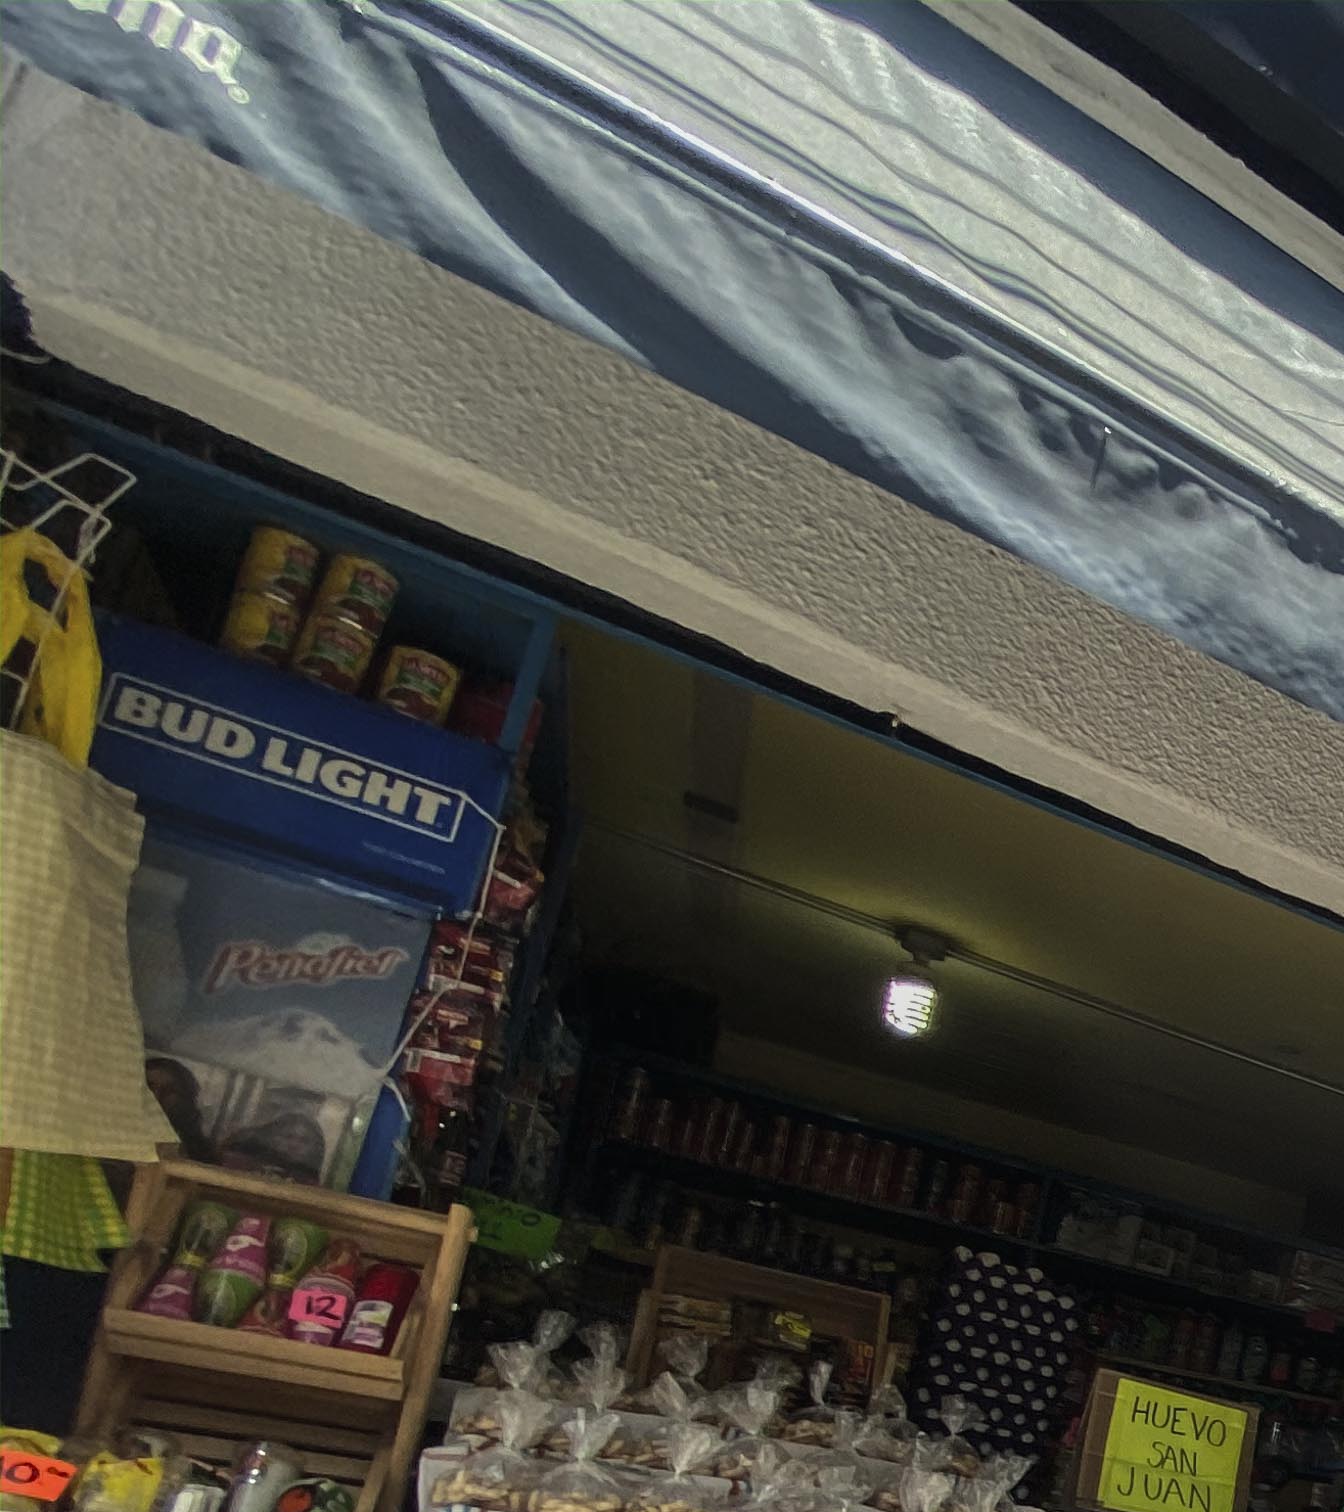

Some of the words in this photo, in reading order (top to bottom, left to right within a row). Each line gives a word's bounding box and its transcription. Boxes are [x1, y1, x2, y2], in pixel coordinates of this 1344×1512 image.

[114, 686, 256, 759] BUD
[261, 736, 451, 826] LIGHT
[306, 1295, 341, 1320] 12
[1131, 1396, 1227, 1447] HUEVO
[1147, 1441, 1198, 1477] SAN
[1117, 1467, 1212, 1512] JUAN
